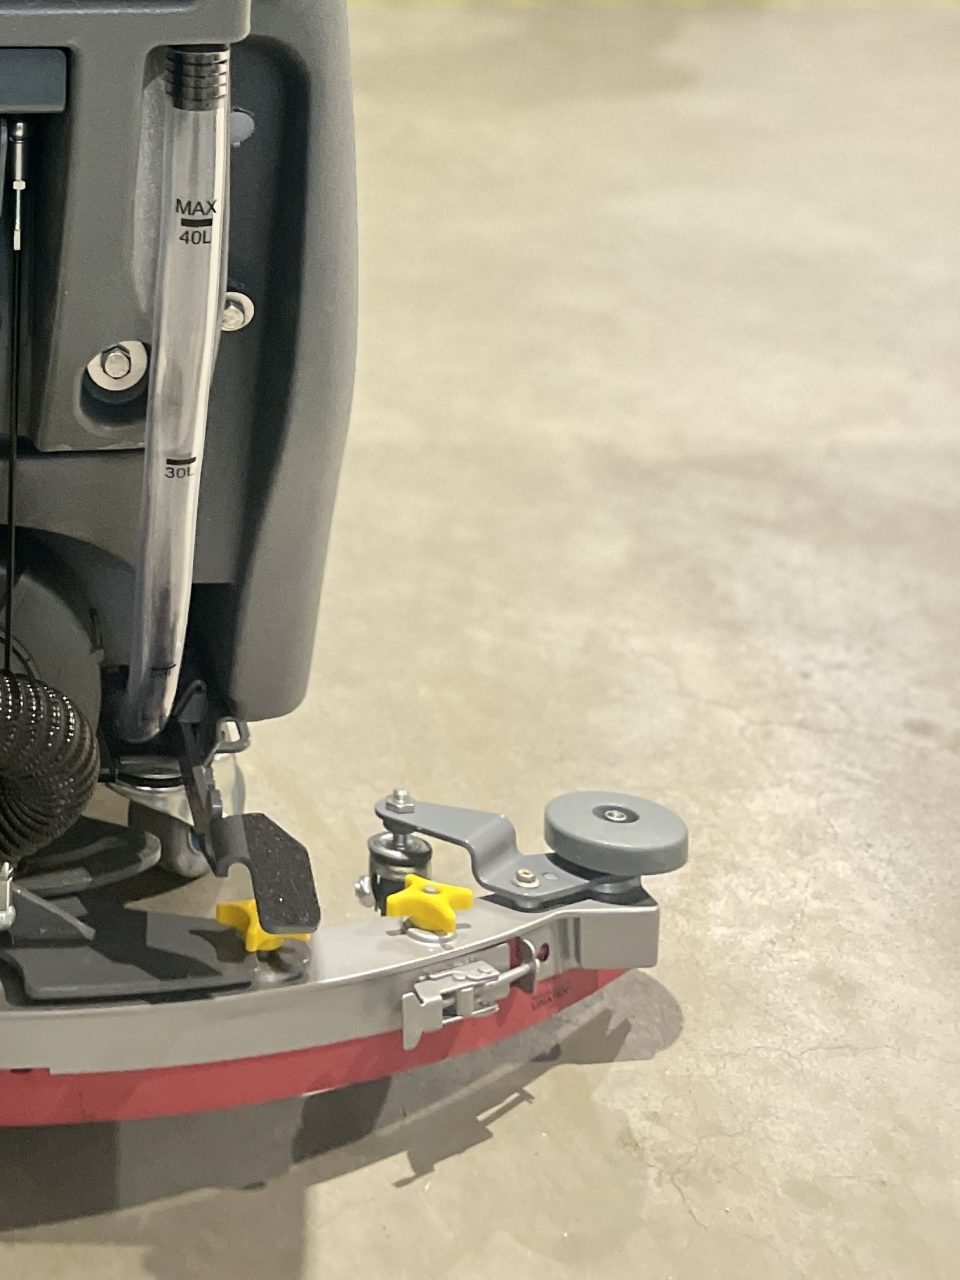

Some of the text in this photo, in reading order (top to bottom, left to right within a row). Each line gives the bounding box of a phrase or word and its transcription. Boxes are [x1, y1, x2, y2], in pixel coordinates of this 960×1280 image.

[175, 198, 217, 216] MAX
[179, 230, 211, 245] 40L
[164, 466, 194, 479] 30L
